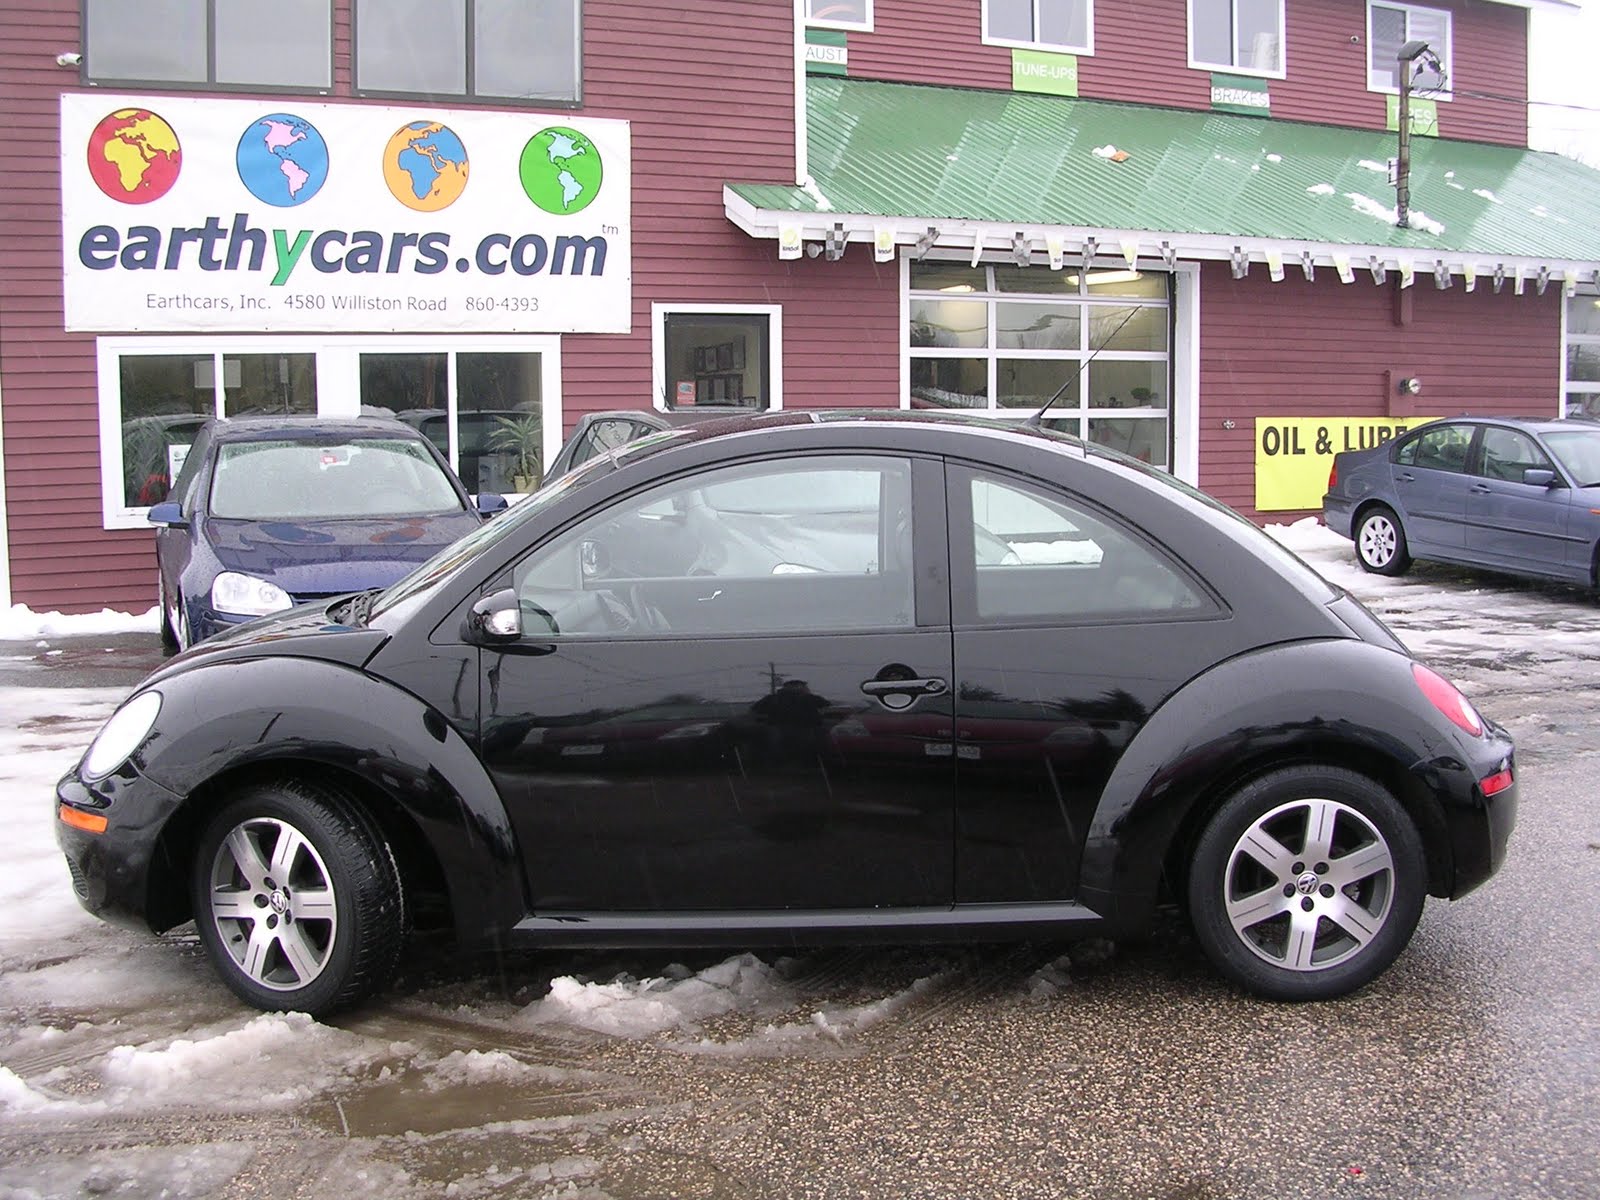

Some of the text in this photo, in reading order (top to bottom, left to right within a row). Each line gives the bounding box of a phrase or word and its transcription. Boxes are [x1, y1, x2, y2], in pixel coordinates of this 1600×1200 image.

[1014, 61, 1077, 81] TUNE-UPS
[1213, 88, 1268, 107] BRAKES
[1391, 105, 1433, 125] TRES
[78, 213, 607, 286] earthycars.com
[146, 293, 540, 312] Earthcars, Inc. 4580 Williston Road 860-4393
[1262, 426, 1306, 456] OIL
[1315, 426, 1333, 455] &
